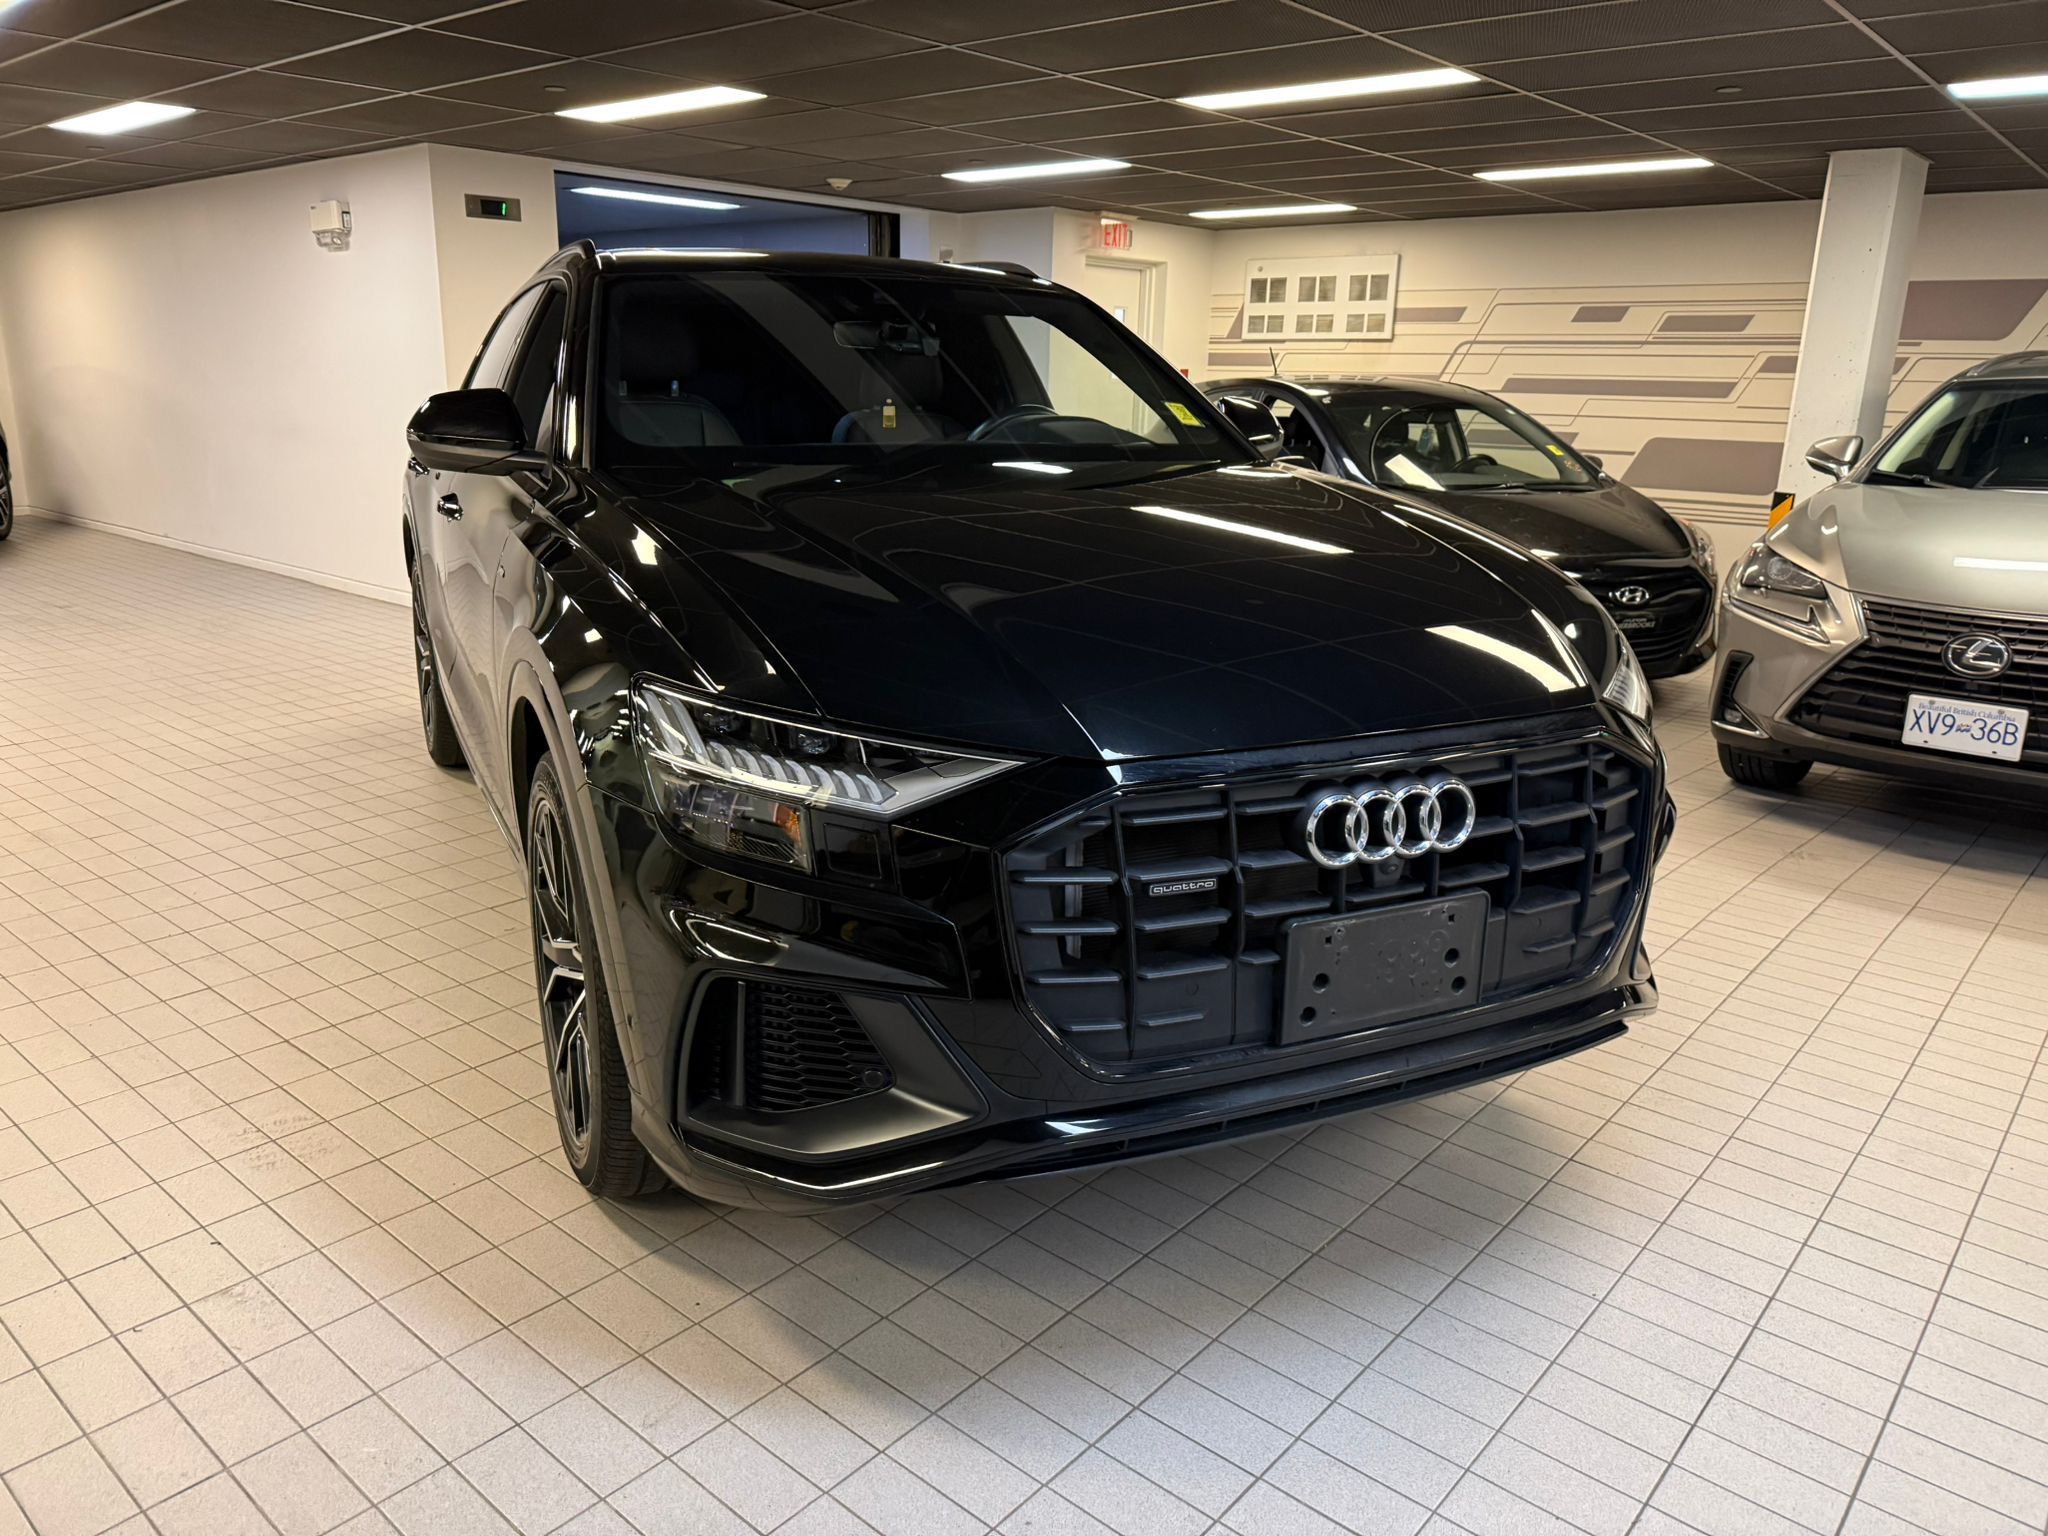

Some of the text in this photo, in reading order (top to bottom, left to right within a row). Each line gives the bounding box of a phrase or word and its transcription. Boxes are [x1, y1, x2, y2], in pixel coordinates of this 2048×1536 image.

[1104, 223, 1129, 248] EXIT
[1919, 703, 2016, 722] Beautiful British Columbia
[1153, 881, 1214, 894] quattro
